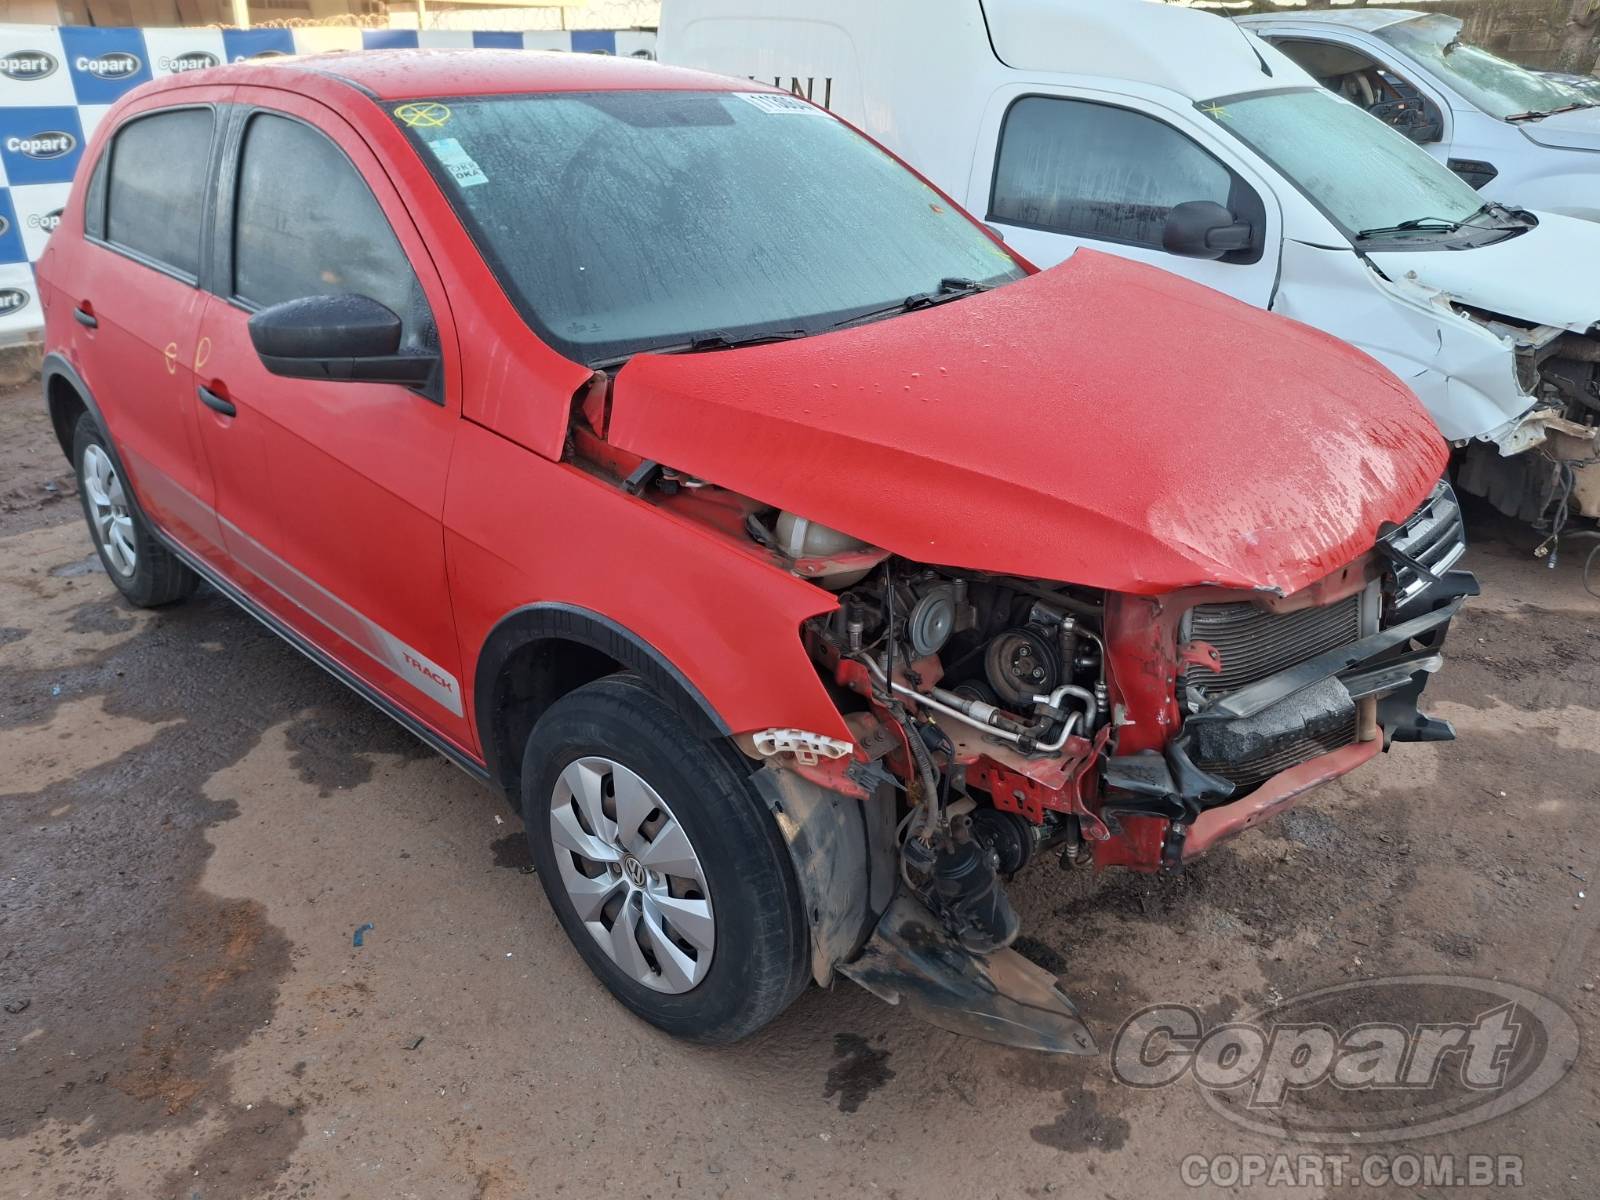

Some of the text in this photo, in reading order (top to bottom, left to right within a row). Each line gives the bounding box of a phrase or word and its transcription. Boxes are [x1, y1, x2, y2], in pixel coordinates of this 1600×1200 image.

[76, 56, 133, 75] Copart
[159, 56, 211, 71] Copart
[7, 136, 68, 154] Copart
[402, 651, 453, 693] TRACK
